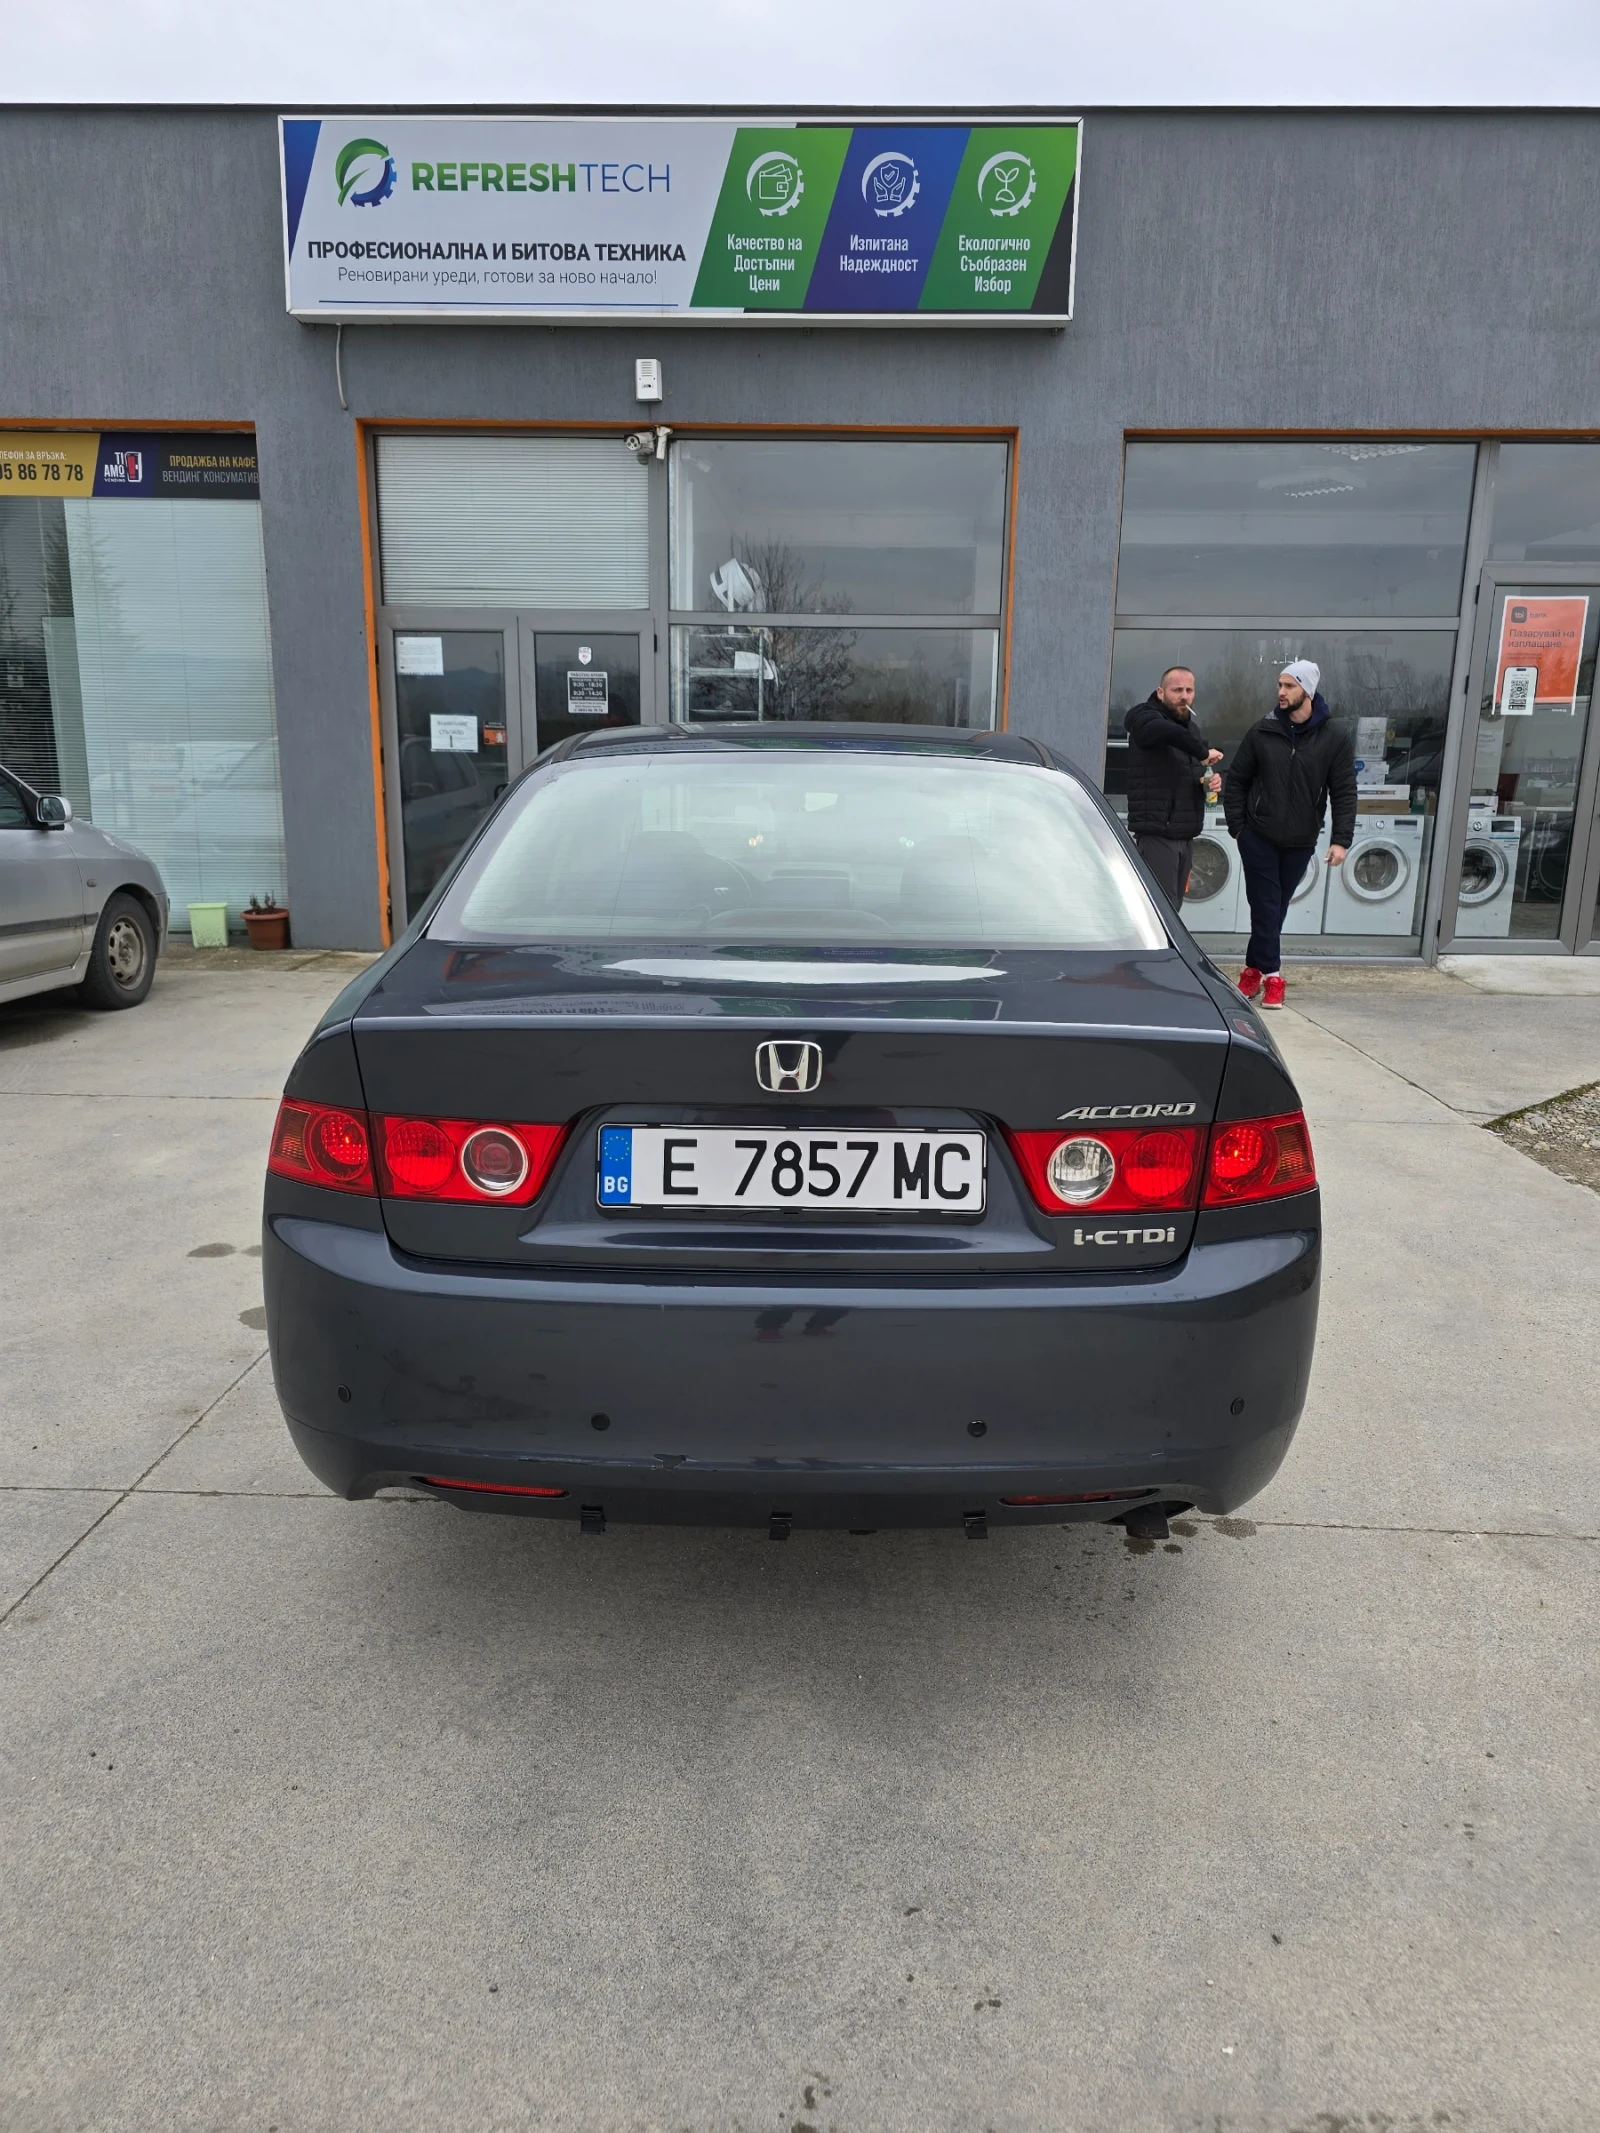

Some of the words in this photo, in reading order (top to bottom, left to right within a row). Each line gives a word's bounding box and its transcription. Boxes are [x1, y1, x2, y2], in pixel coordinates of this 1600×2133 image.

[411, 162, 670, 192] REFRESHTECH
[307, 240, 488, 261] ПРОФЕСИОНАЛНА
[493, 242, 508, 261] И
[511, 242, 591, 262] БИТОВА
[594, 243, 686, 262] ТЕХНИКА
[727, 233, 785, 251] Качество
[787, 237, 803, 251] на
[850, 234, 909, 252] Изпитана
[958, 234, 1031, 252] Екологично
[733, 255, 795, 273] Достъпни
[840, 255, 918, 274] Надеждност
[960, 256, 1027, 274] Съобразен
[338, 266, 429, 286] Реновирани
[432, 269, 480, 286] уреди,
[483, 271, 534, 284] готови
[538, 271, 555, 284] за
[559, 272, 596, 284] ново
[600, 270, 658, 285] начало!
[749, 275, 780, 293] Цени
[974, 276, 1011, 295] Избор
[25, 451, 35, 460] ЗА
[36, 451, 67, 460] ВРЪЗКА:
[169, 455, 218, 468] ПРОДАЖБА
[219, 456, 231, 468] НА
[232, 456, 257, 468] КАФЕ
[18, 463, 37, 481] 86
[41, 464, 61, 481] 78
[64, 464, 84, 482] 78
[162, 470, 201, 484] ВЕНДИНГ
[1514, 611, 1525, 619] tbi
[1529, 611, 1548, 619] bank
[1508, 628, 1561, 639] Пазарувай
[1562, 630, 1575, 638] на
[1507, 640, 1562, 649] изплащане
[1057, 1102, 1197, 1121] ACCORD
[662, 1139, 699, 1196] E
[734, 1139, 879, 1199] 7857
[893, 1142, 970, 1200] MC
[603, 1176, 629, 1194] BG
